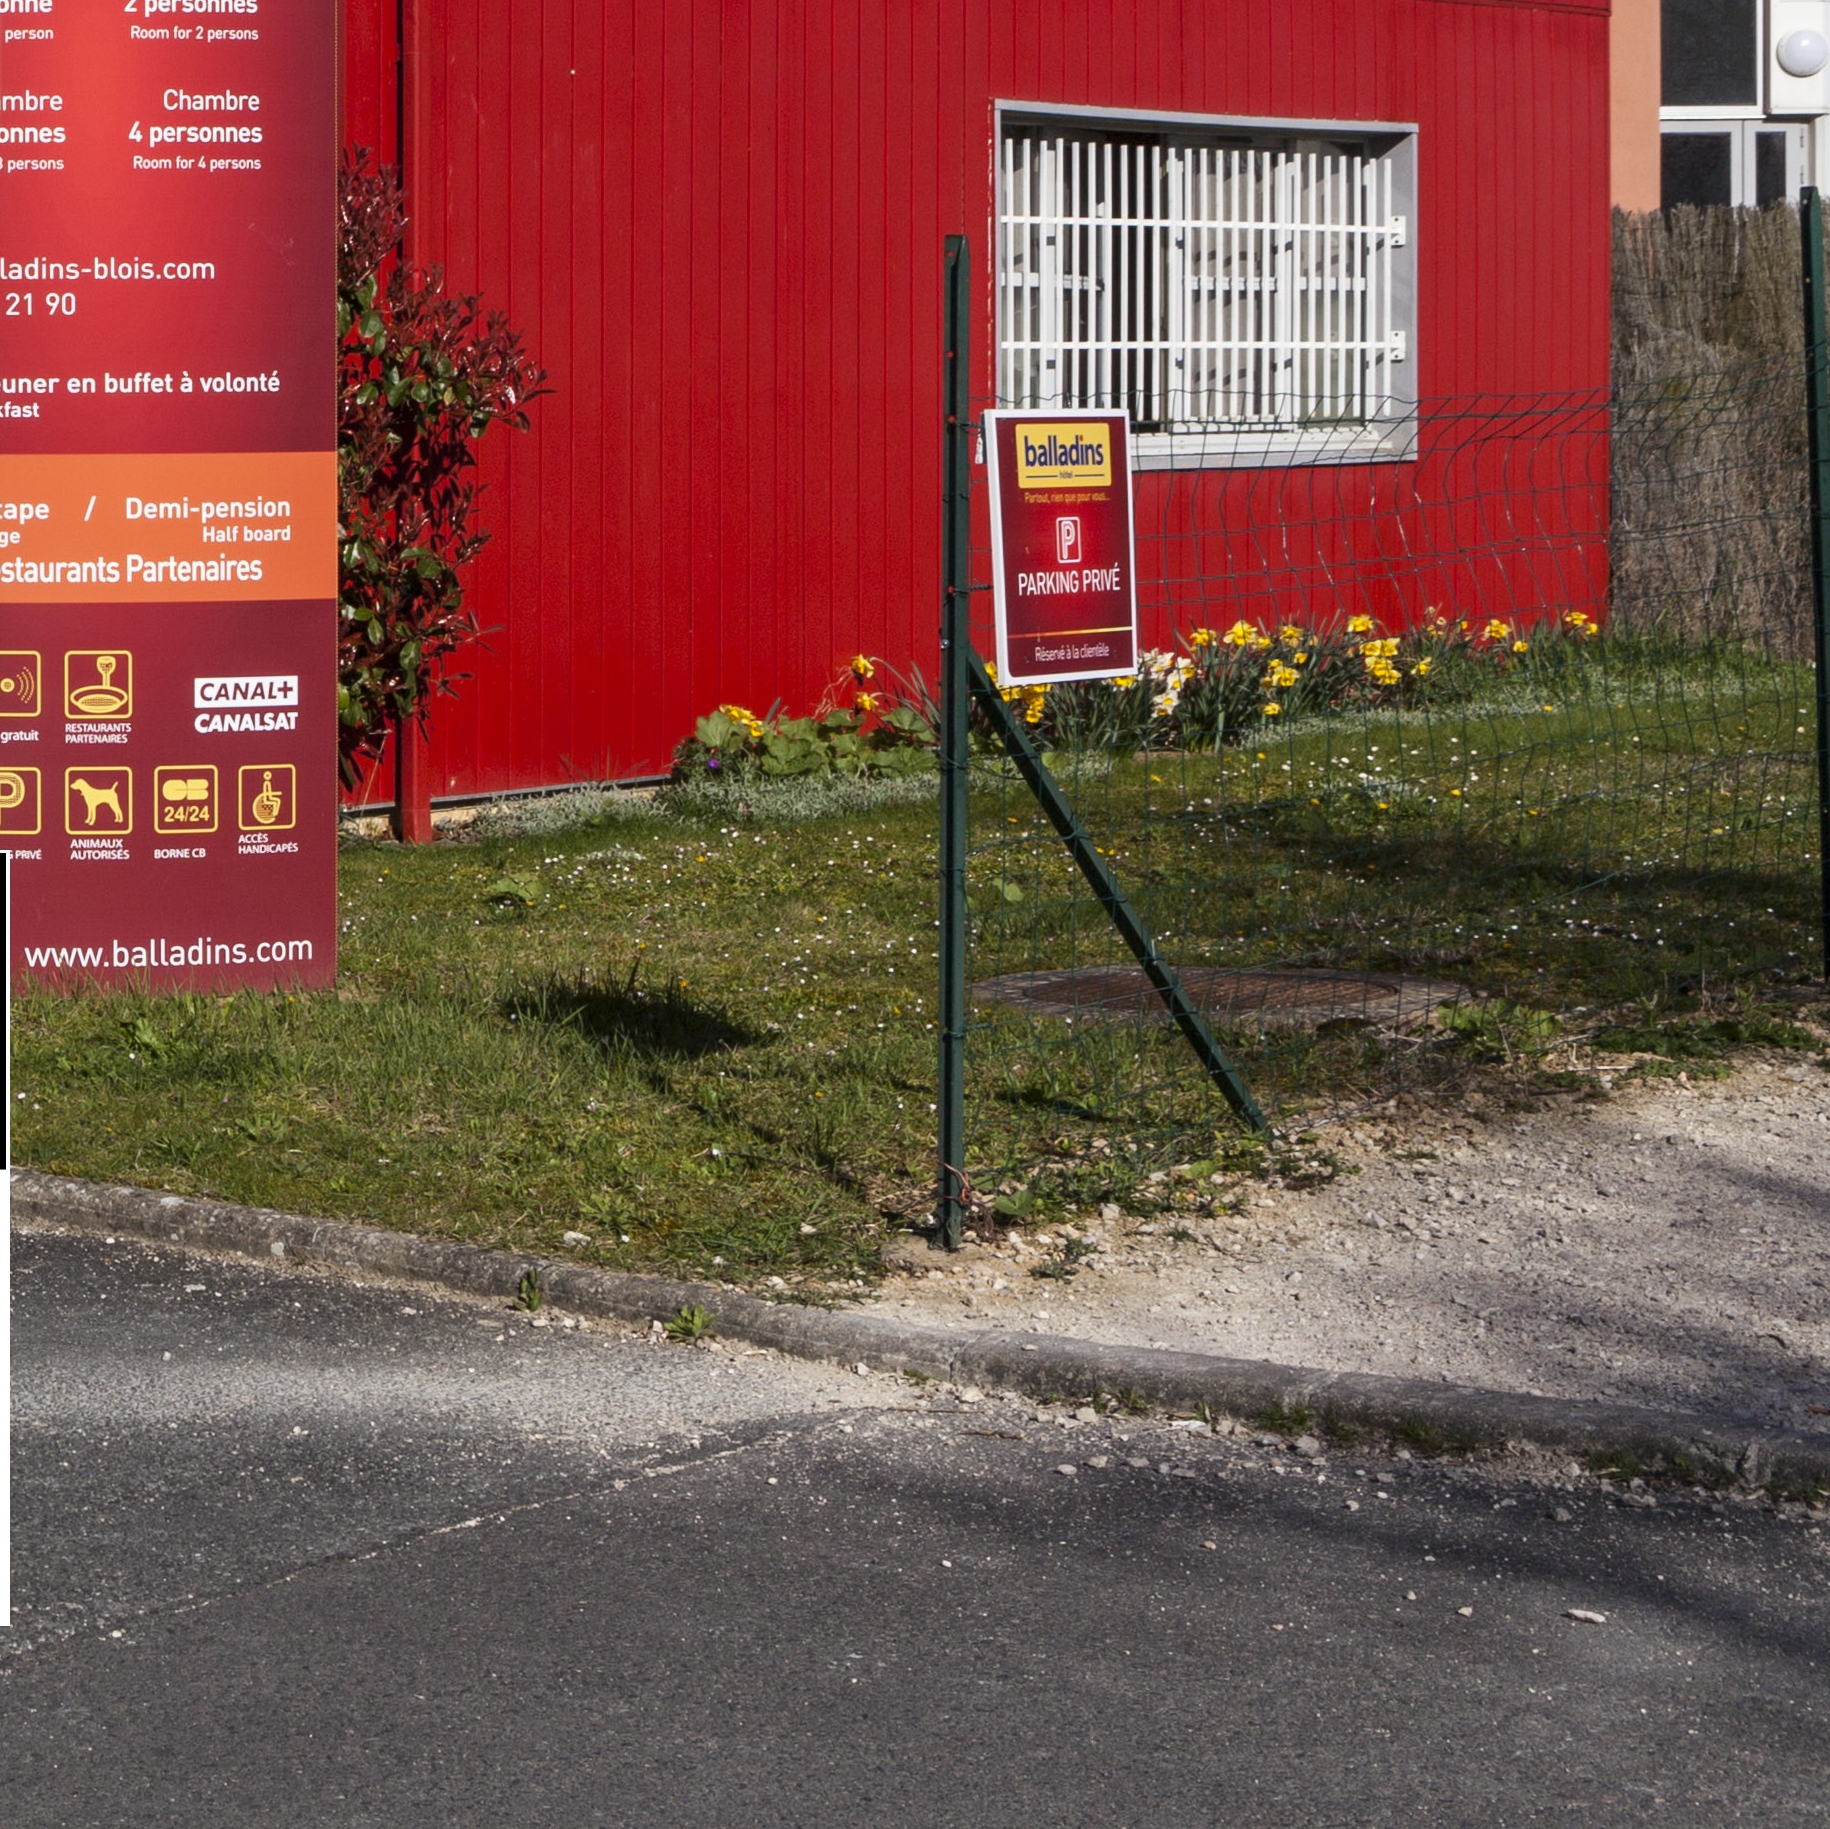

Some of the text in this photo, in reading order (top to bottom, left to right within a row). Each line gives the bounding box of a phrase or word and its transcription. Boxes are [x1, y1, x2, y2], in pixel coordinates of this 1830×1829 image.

[5, 28, 54, 44] person
[130, 25, 259, 43] Room for 2 persons
[162, 88, 260, 112] Chambre
[128, 122, 263, 148] 4 personnes
[7, 158, 64, 174] persons
[133, 155, 261, 172] Room for 4 persons
[6, 294, 35, 316] 21
[45, 293, 77, 316] 90
[67, 377, 96, 394] en
[105, 372, 174, 394] buffet
[180, 371, 193, 393] à
[200, 370, 281, 393] volonté
[1024, 435, 1104, 467] balladins
[1025, 492, 1049, 504] Partout,
[125, 496, 291, 521] Demi-pension
[203, 524, 291, 542] Half board
[127, 553, 263, 581] Partenaires
[1018, 562, 1120, 596] PARKING PRIVÉ
[200, 681, 293, 702] CANAL+
[65, 723, 132, 733] RESTAURANTS
[194, 712, 298, 734] CANALSAT
[1, 730, 39, 743] gratuit
[65, 734, 128, 744] PARTENAIRES
[164, 806, 210, 823] 24/24
[70, 839, 123, 849] ANIMAUX
[238, 843, 298, 854] HANDICAPÉS
[15, 849, 42, 860] PRIVÉ
[70, 849, 130, 860] AUTORISÉS
[154, 848, 206, 859] BORNE CB
[24, 938, 313, 968] www.balladins.com
